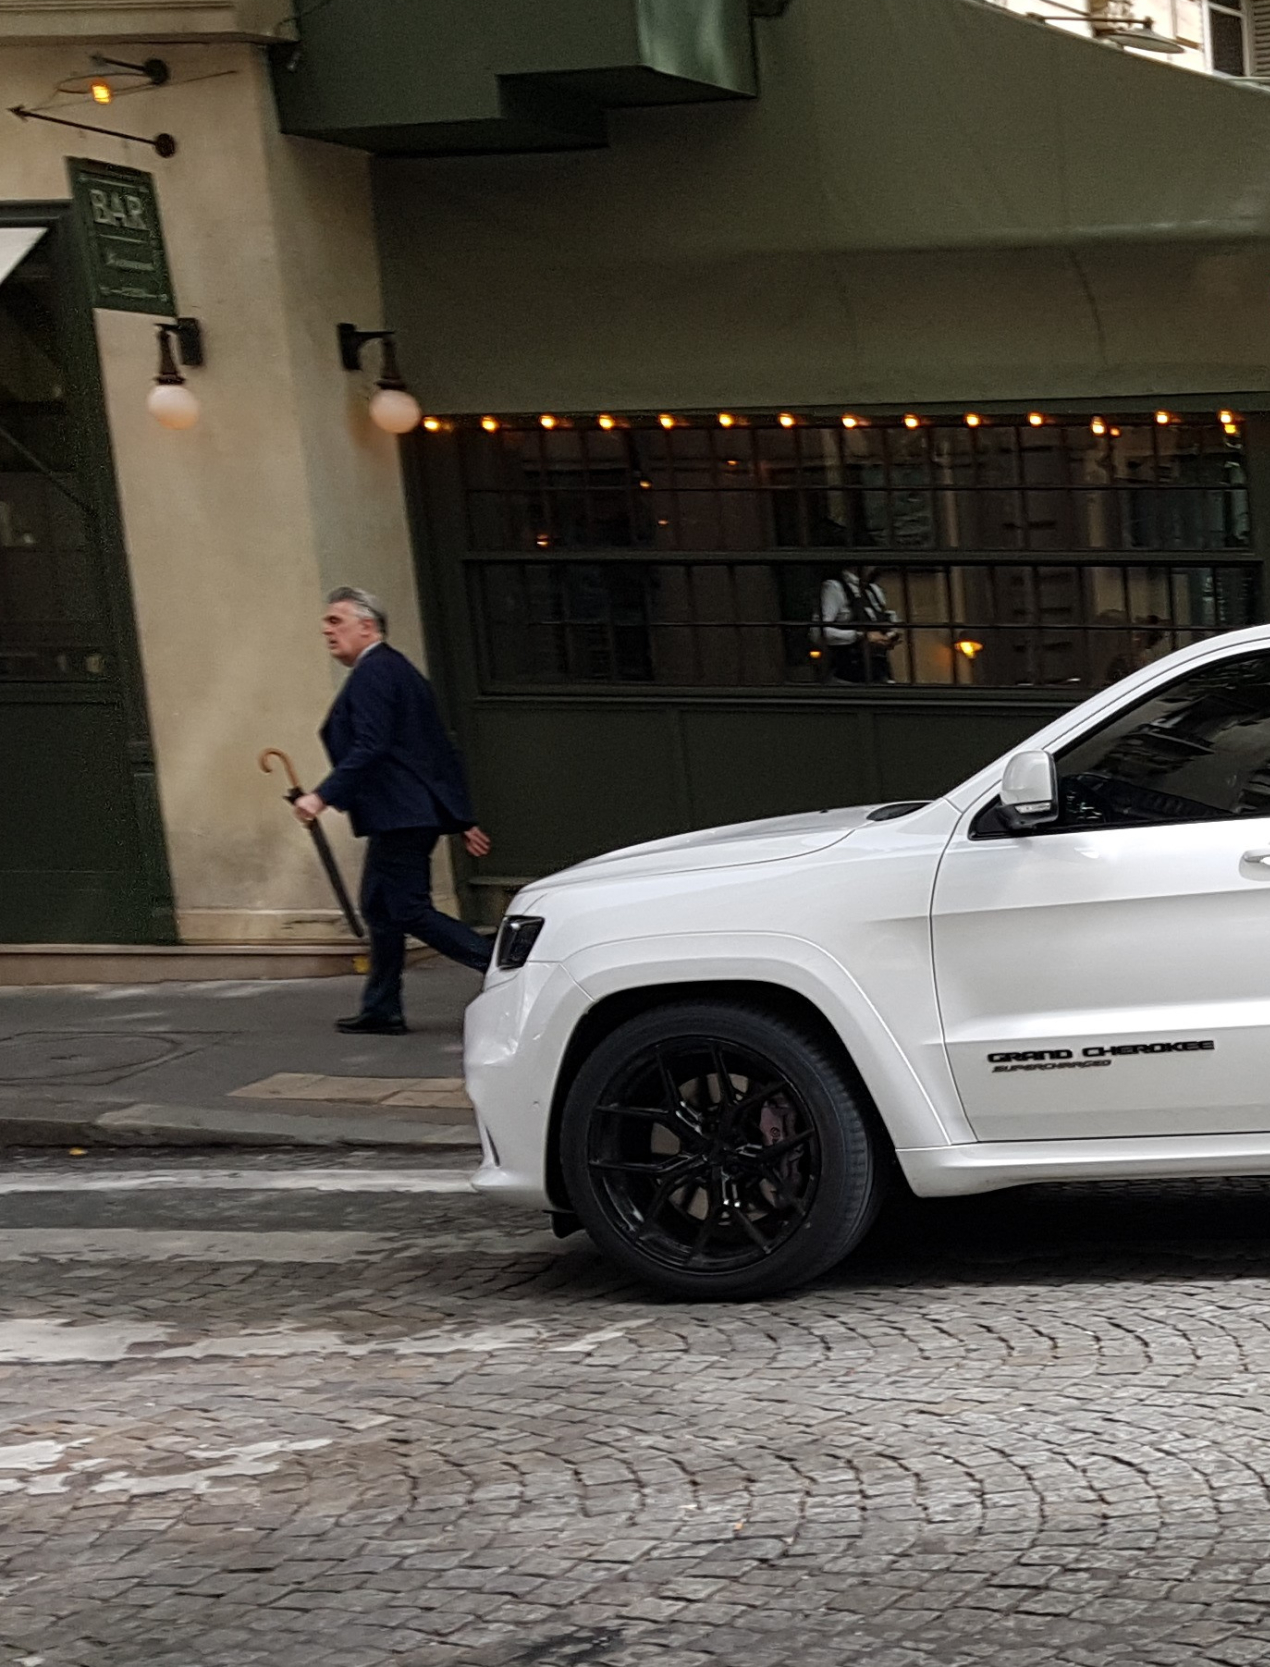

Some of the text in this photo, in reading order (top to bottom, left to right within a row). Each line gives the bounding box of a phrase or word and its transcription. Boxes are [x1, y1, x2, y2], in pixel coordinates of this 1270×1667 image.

[89, 188, 148, 229] BAR
[987, 1040, 1215, 1063] GRAND CHEROKEE
[991, 1059, 1112, 1073] SUPERCHARGED
